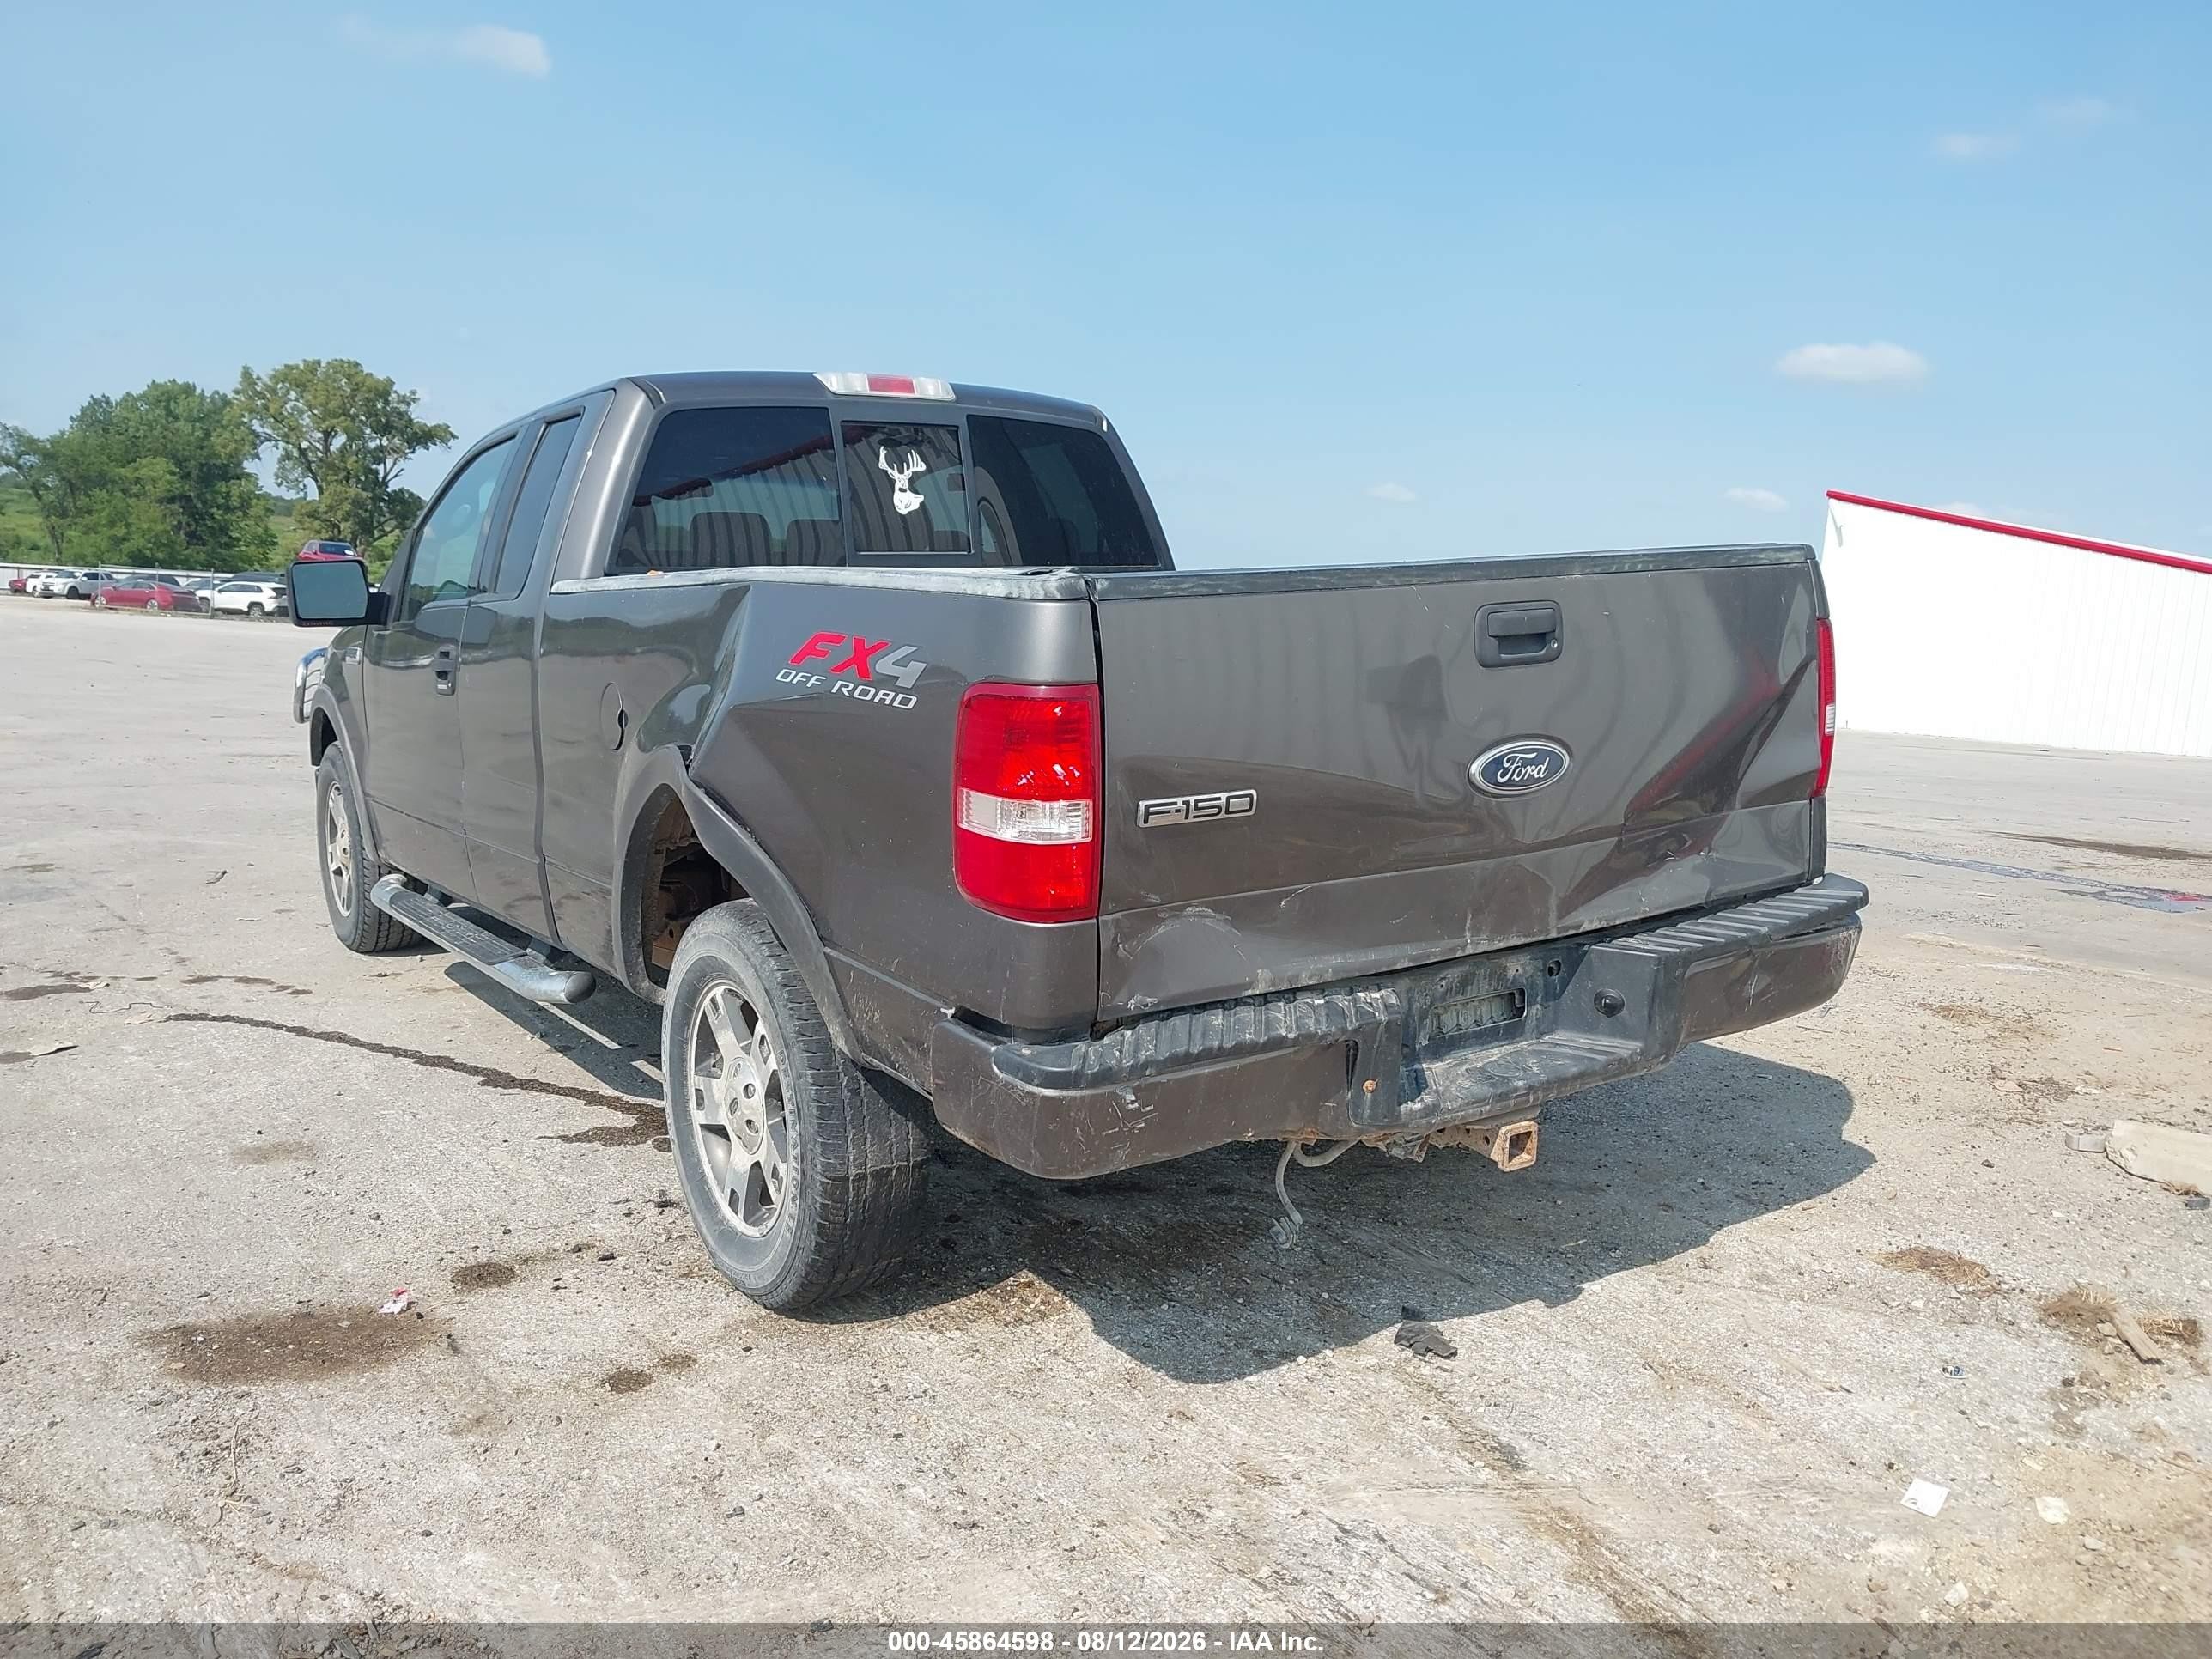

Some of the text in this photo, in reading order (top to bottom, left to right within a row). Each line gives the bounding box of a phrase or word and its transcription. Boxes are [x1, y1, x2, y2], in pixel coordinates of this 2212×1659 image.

[788, 631, 927, 689] FX4
[775, 668, 917, 709] OFF ROAD
[1497, 752, 1550, 783] Ford
[1143, 793, 1254, 824] F-150
